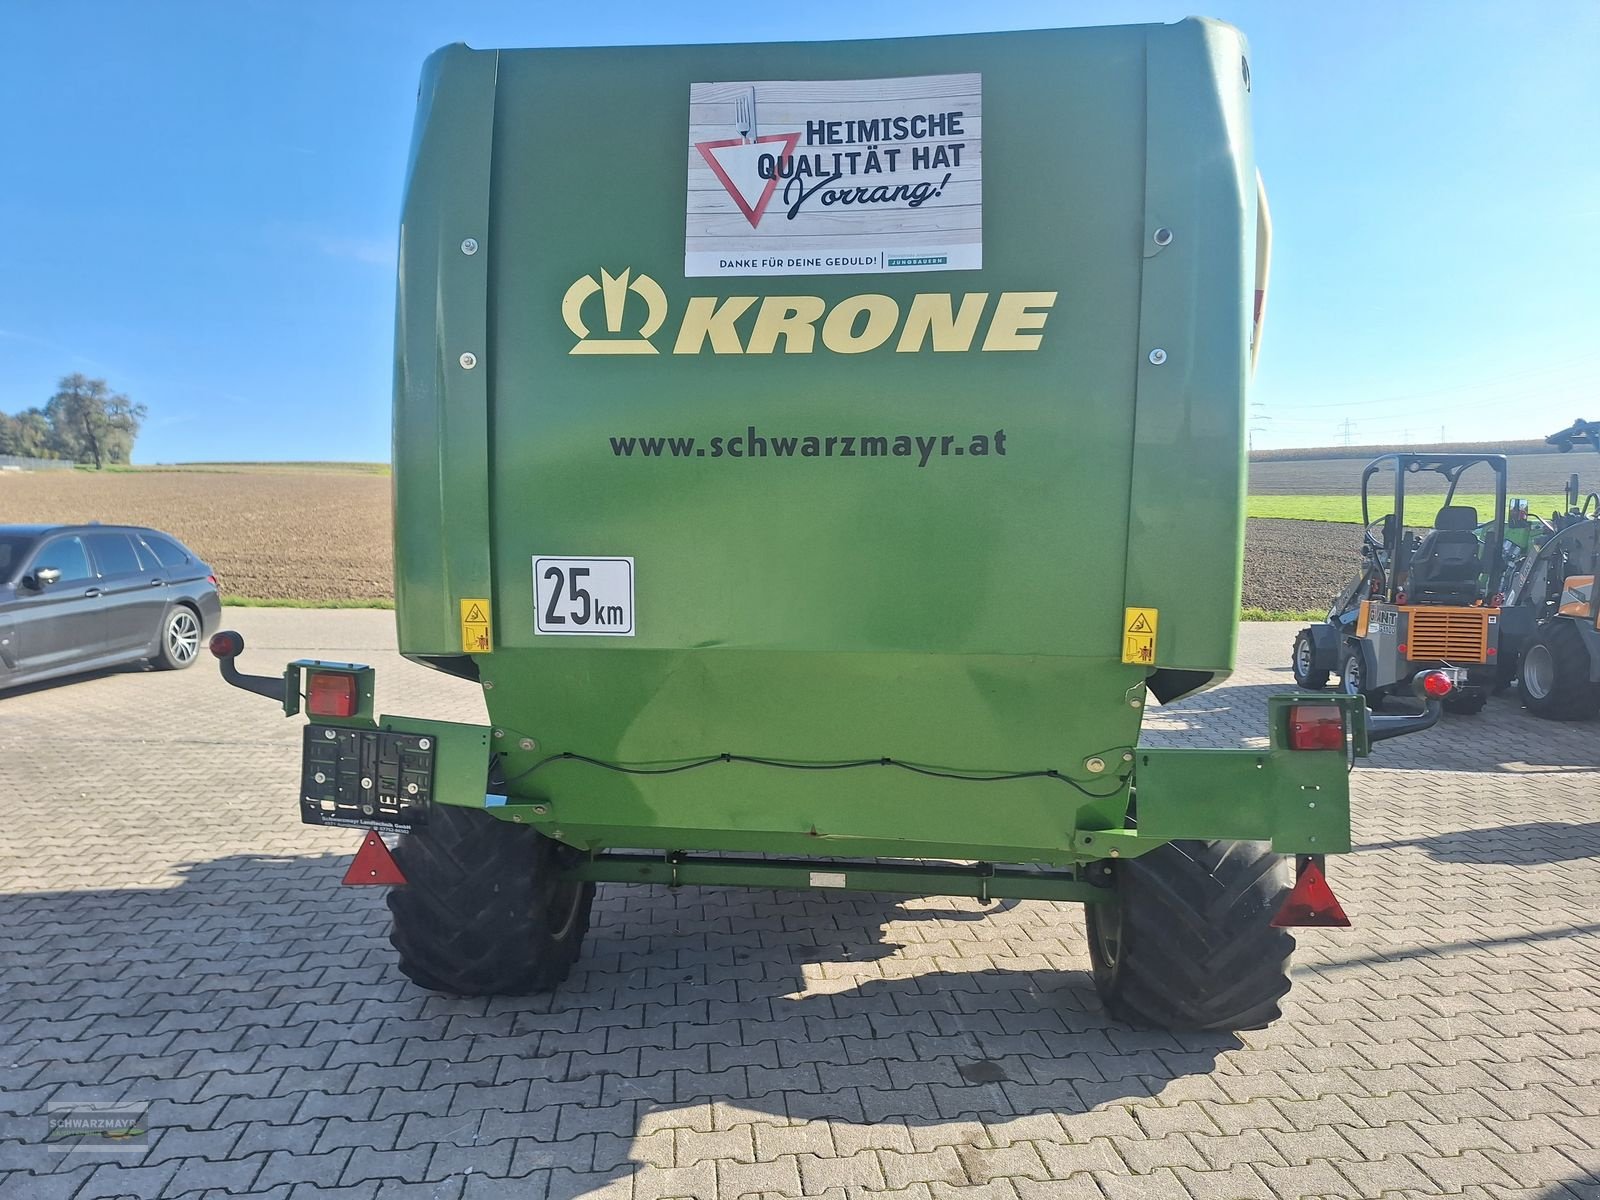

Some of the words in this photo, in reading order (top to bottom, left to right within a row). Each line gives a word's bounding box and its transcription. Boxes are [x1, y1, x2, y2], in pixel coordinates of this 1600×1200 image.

[806, 111, 965, 145] HEIMISCHE
[757, 145, 901, 180] QUALITÄT
[912, 143, 965, 171] HAT
[783, 173, 952, 220] Vorrang!
[719, 258, 758, 268] DANKE
[761, 256, 784, 268] FÜR
[787, 258, 822, 267] DEINE
[825, 256, 877, 266] GEDULD!
[673, 291, 1058, 355] KRONE
[609, 426, 1007, 468] www.schwarzmayr.at
[544, 566, 591, 625] 25
[594, 599, 623, 625] km
